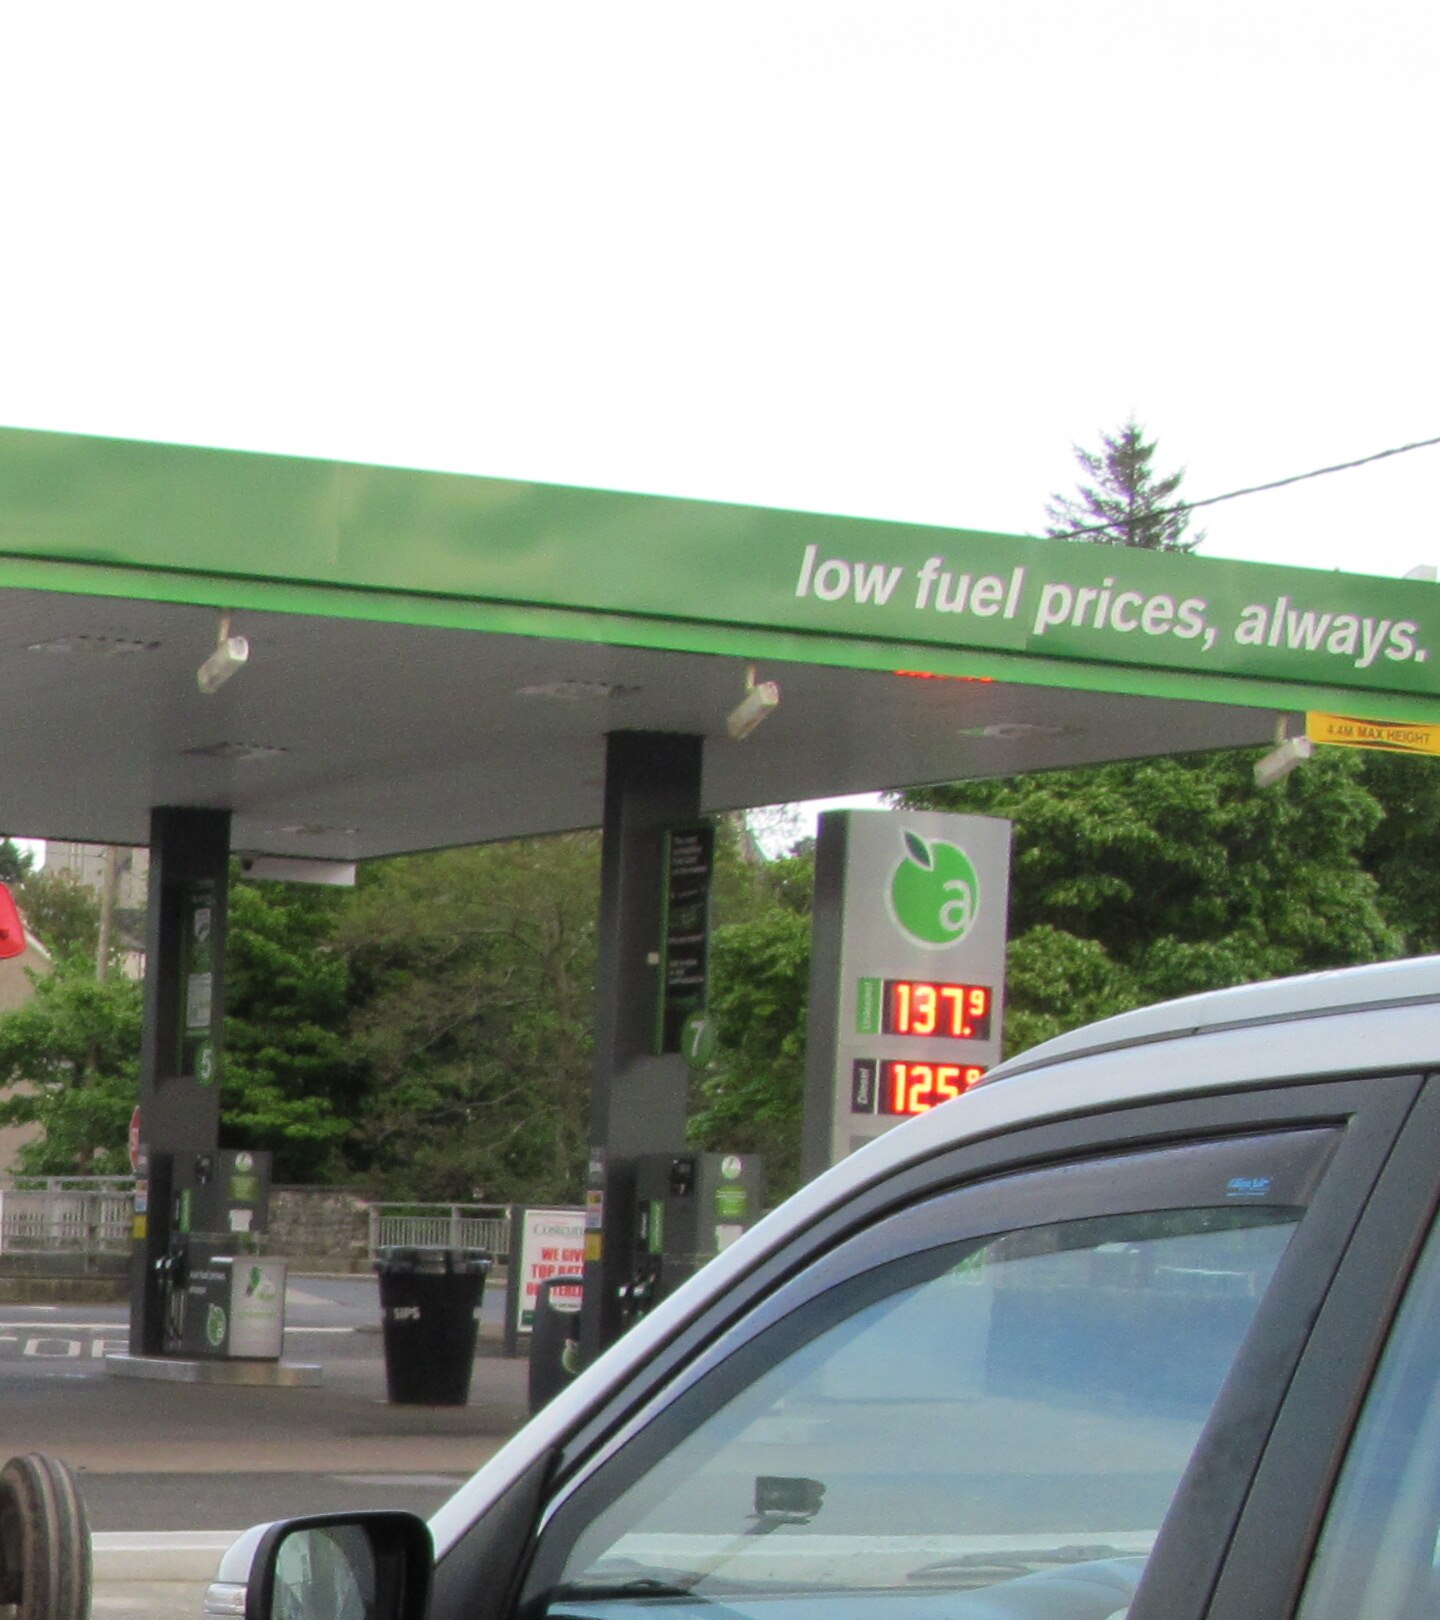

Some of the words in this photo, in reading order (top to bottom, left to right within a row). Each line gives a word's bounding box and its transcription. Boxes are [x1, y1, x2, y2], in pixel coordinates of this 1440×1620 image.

[795, 544, 902, 606] low
[913, 556, 1027, 621] fuel
[1032, 577, 1219, 653] prices,
[1233, 596, 1429, 669] always.
[1357, 725, 1384, 740] MAX
[1385, 729, 1431, 745] HEIGHT
